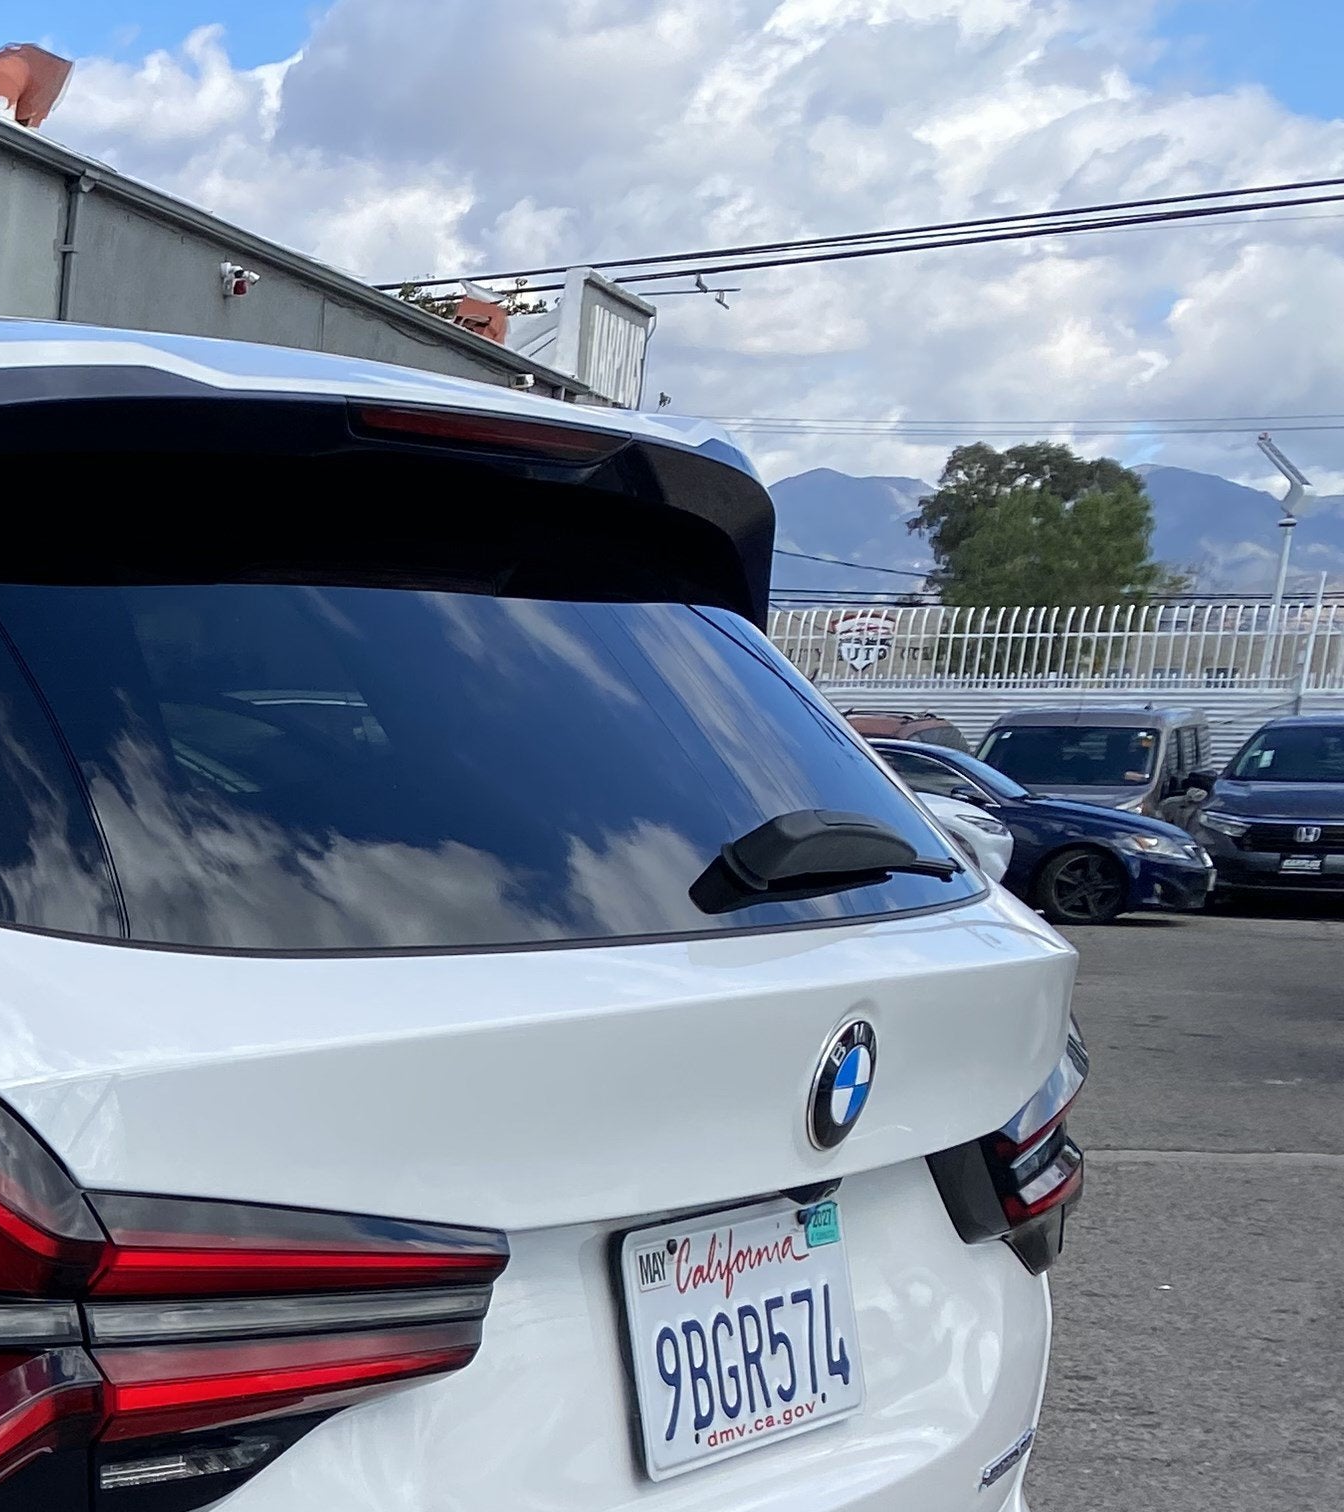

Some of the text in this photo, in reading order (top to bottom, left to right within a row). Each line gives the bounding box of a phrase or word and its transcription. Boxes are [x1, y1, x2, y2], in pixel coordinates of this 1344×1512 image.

[639, 1253, 667, 1286] MAY
[675, 1229, 810, 1299] California
[656, 1283, 851, 1442] 9BGR574
[707, 1400, 817, 1448] dmv.ca.gov
